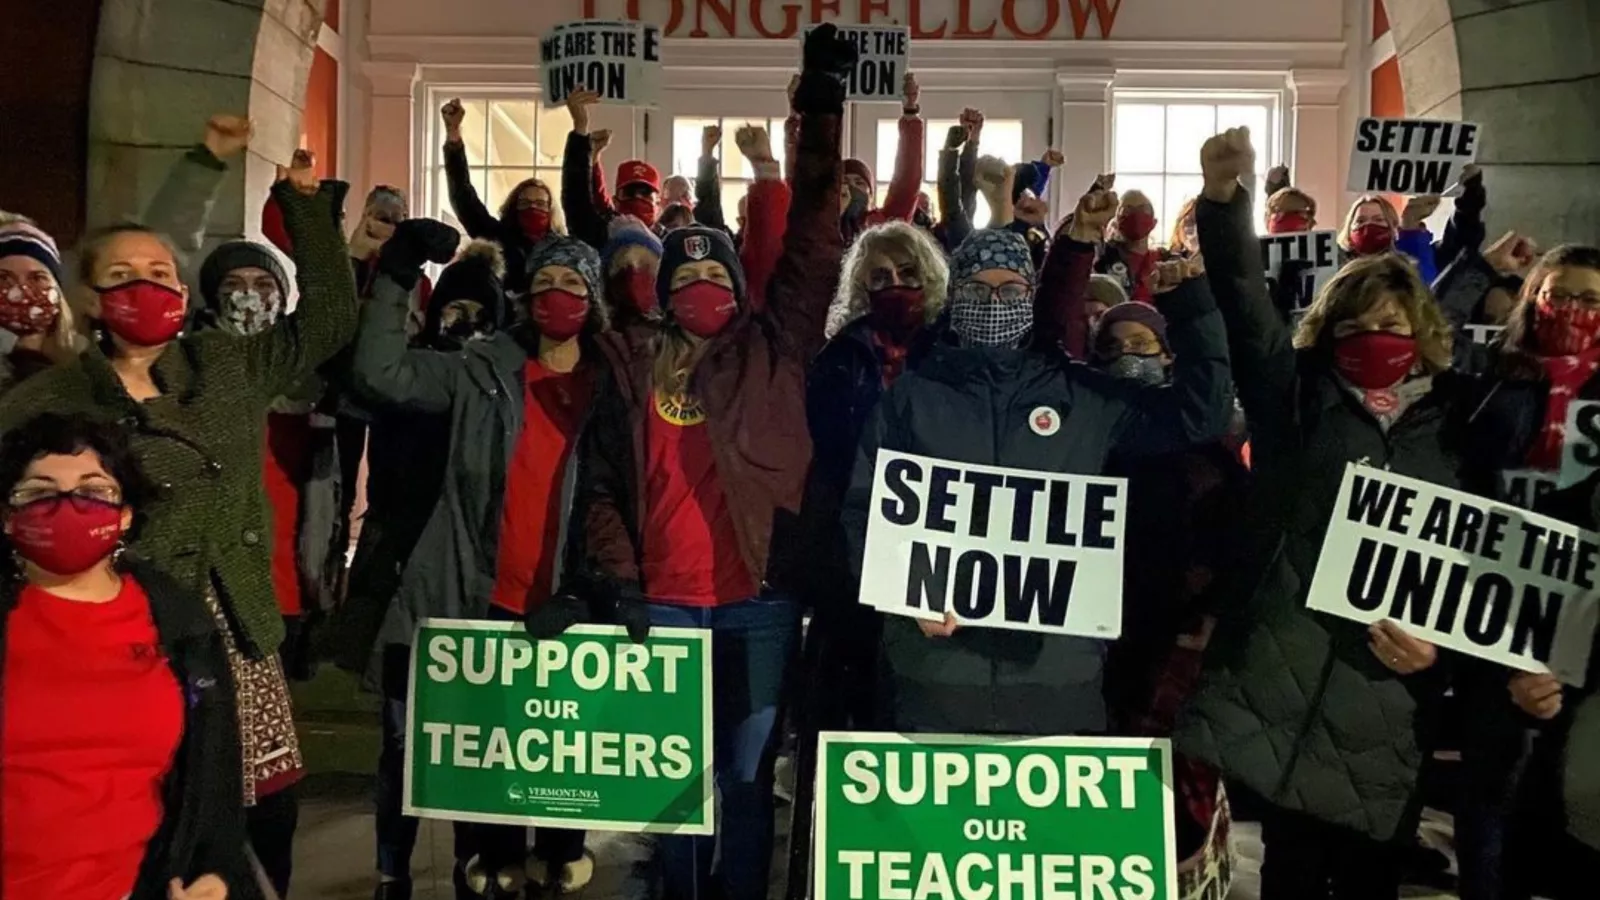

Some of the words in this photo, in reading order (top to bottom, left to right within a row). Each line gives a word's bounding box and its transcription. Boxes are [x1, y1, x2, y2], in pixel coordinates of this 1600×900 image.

[564, 31, 596, 57] ARE
[601, 31, 636, 57] THE
[873, 32, 905, 55] THE
[549, 61, 625, 103] UNION
[849, 61, 895, 95] ION
[1357, 119, 1477, 156] SETTLE
[1366, 158, 1452, 193] NOW
[1261, 233, 1333, 270] TTLE
[881, 458, 1118, 549] SETTLE
[1347, 475, 1417, 535] WE
[1418, 496, 1509, 561] ARE
[1518, 521, 1600, 590] THE
[905, 541, 1077, 627] NOW
[1346, 537, 1565, 663] UNION
[426, 635, 689, 693] SUPPORT
[524, 699, 580, 720] OUR
[422, 722, 693, 779] TEACHERS
[528, 787, 600, 799] VERMONT-NEA
[841, 750, 1148, 809] SUPPORT
[963, 819, 1027, 841] OUR
[838, 850, 1156, 900] TEACHERS
